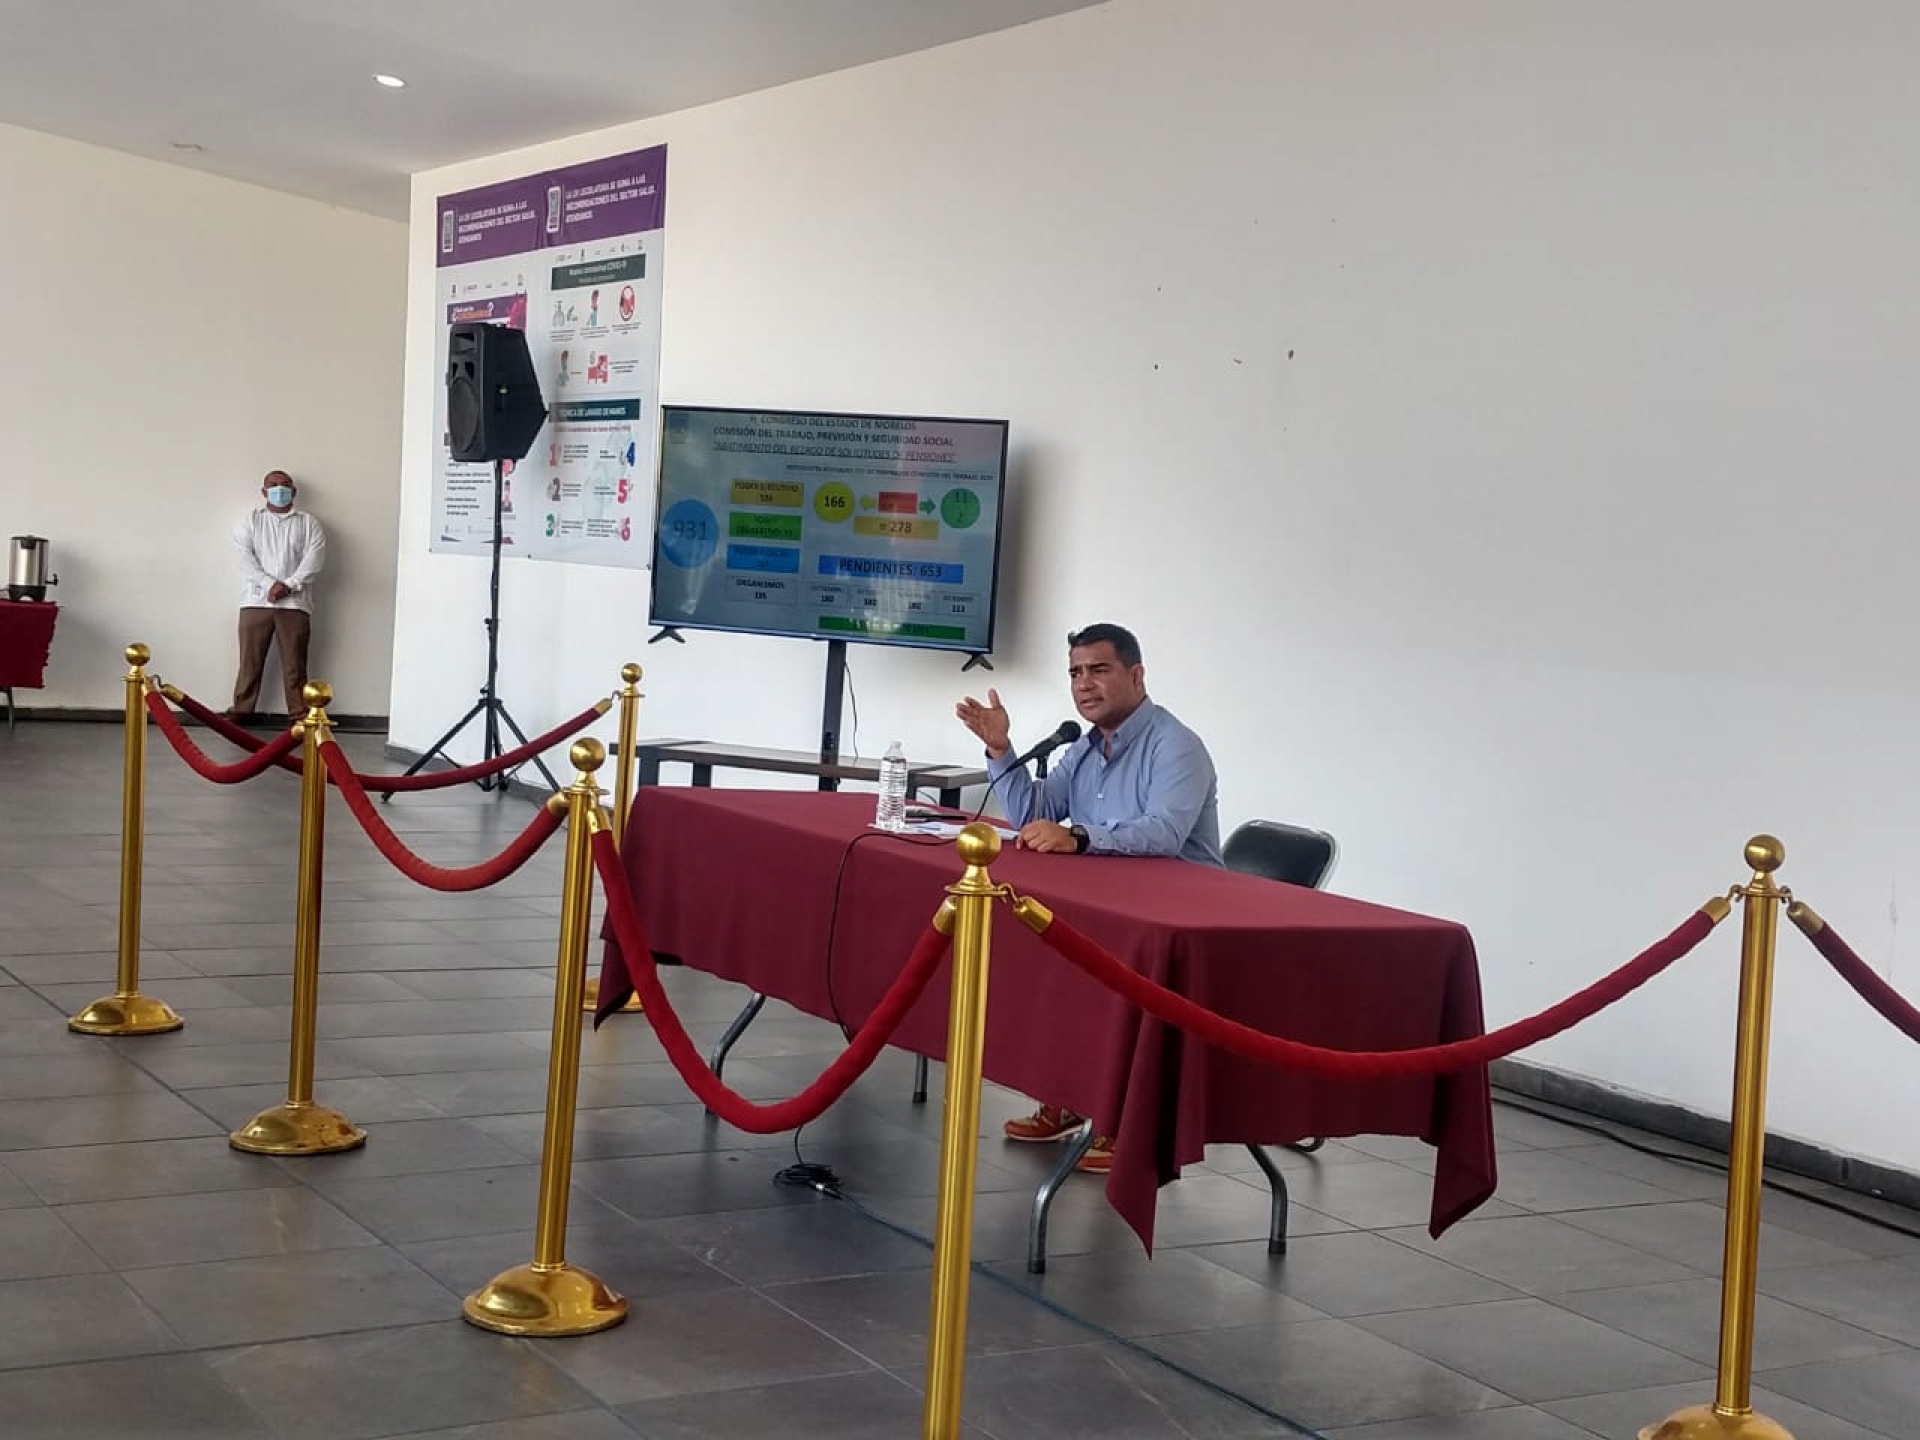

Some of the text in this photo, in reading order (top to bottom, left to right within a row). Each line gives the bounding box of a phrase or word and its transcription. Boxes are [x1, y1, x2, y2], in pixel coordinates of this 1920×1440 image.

[810, 418, 824, 426] DEL
[826, 419, 859, 428] ESTADO
[861, 420, 871, 429] DE
[875, 421, 916, 430] MORELOS
[714, 425, 756, 437] COMISIÓN
[758, 429, 772, 439] DEL
[871, 434, 920, 445] SEGURIDAD
[923, 436, 955, 446] SOCIAL
[549, 444, 558, 467] 1
[627, 441, 636, 467] 4
[552, 477, 561, 501] 2
[618, 479, 628, 504] 5
[824, 495, 846, 509] 166
[621, 517, 630, 542] 6
[673, 520, 706, 540] 931
[890, 522, 912, 533] 278
[920, 564, 942, 578] 653
